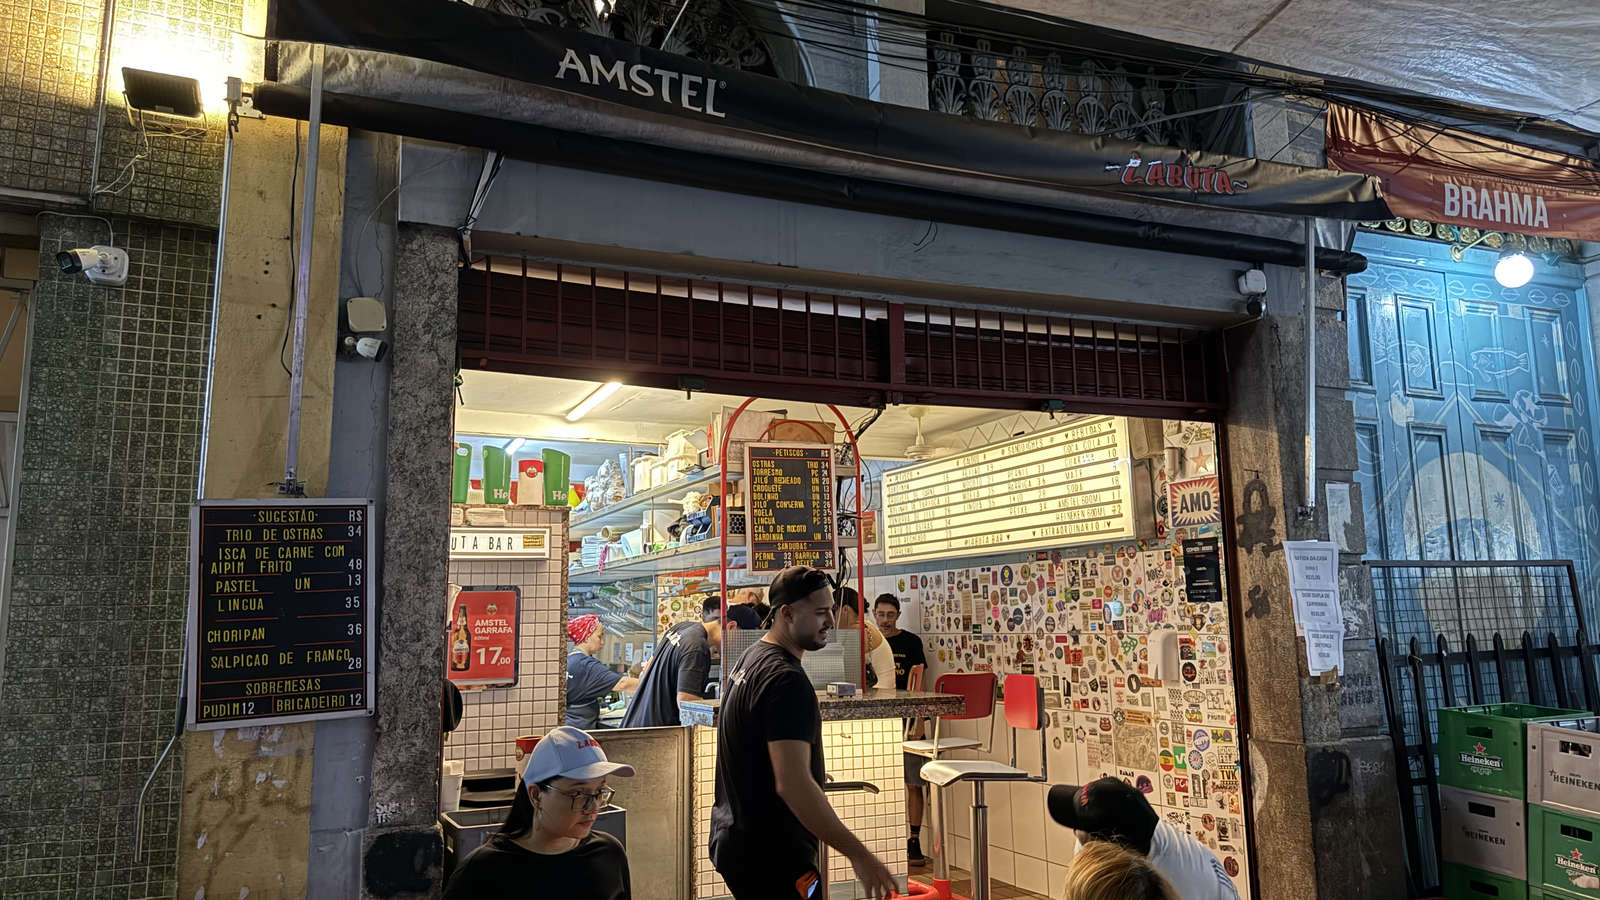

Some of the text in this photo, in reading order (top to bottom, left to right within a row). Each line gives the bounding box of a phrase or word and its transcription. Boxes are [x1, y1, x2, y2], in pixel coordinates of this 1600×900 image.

[1121, 151, 1234, 194] LABUTA
[1444, 183, 1549, 228] BRAHMA
[1071, 424, 1102, 438] BEBIDAS
[1083, 438, 1102, 450] COLA
[1106, 434, 1116, 444] 10
[775, 449, 804, 457] PETISCOS
[752, 460, 775, 468] OSTRAS
[752, 484, 782, 492] CROQUETE
[1066, 483, 1083, 494] SODA
[775, 500, 804, 508] CONSERVA
[1180, 490, 1212, 514] AMO
[753, 508, 773, 516] MOELA
[1055, 508, 1086, 521] HEINEKEN
[226, 525, 361, 541] TRIO DE OSTRAS 34
[489, 536, 513, 550] BAR
[777, 542, 808, 550] SANDUBAS
[219, 545, 345, 560] ISCA DE CARNE COM
[783, 552, 792, 560] 32
[794, 552, 820, 560] BARRICA
[211, 559, 362, 575] AIPIM FRITO 48
[216, 574, 361, 593] PASTEL UN 13
[345, 597, 360, 608] 35
[474, 619, 508, 627] AMSTEL
[207, 624, 362, 643] CHORIPAN 36
[280, 652, 294, 665] DE
[307, 648, 351, 664] FRANGO
[348, 658, 362, 670] 28
[475, 646, 511, 667] 17,00
[246, 679, 321, 695] SOBREMESAS
[203, 694, 362, 718] PUDIM 12 BRIGADEIRO 12
[1461, 753, 1501, 768] Heineken
[1221, 770, 1237, 780] TVK
[1553, 775, 1600, 791] HEINEKEN
[1464, 831, 1506, 846] HEINEKEN
[1556, 856, 1597, 875] Heineken
